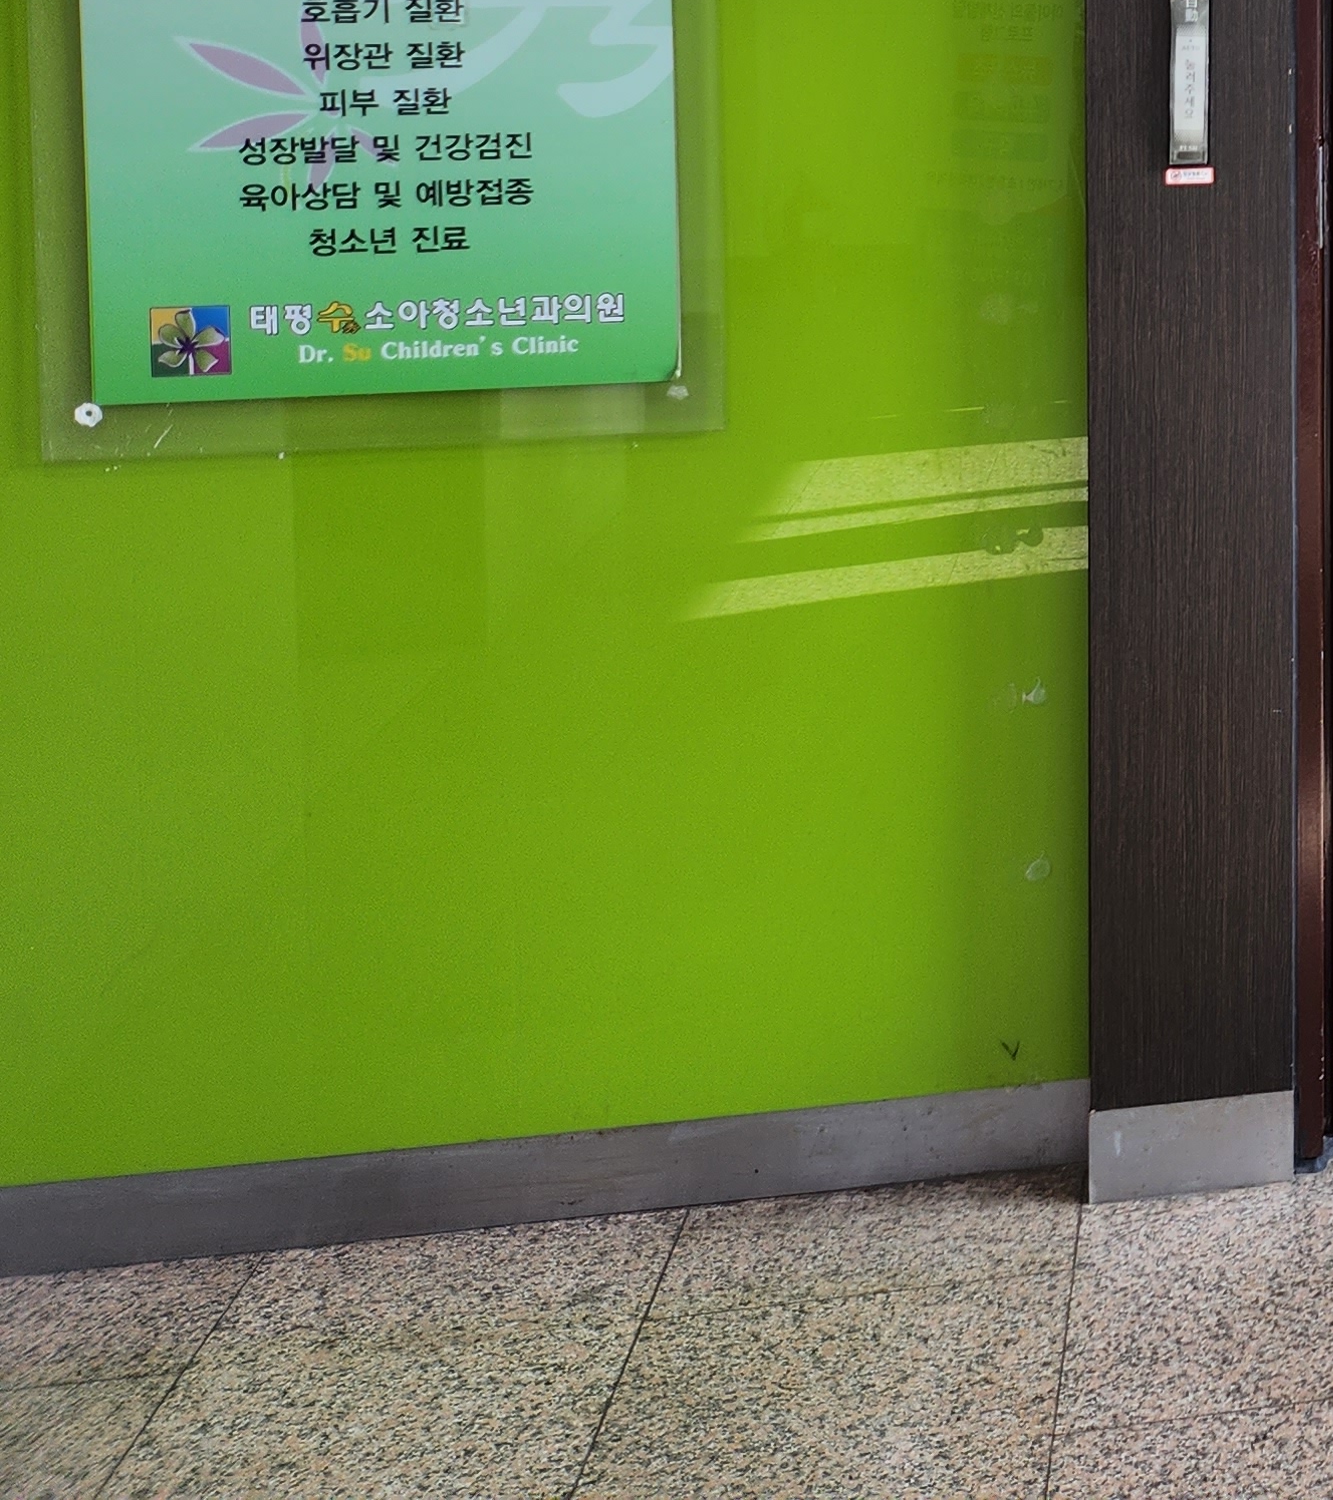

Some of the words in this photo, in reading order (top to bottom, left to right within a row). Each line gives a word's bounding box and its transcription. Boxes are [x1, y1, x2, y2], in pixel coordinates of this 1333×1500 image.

[303, 42, 392, 71] 위장관
[406, 41, 464, 70] 질환
[319, 89, 379, 117] 피부
[392, 87, 451, 116] 질환
[238, 135, 358, 166] 성장발달
[372, 134, 400, 162] 및
[415, 132, 533, 160] 건강검진
[239, 182, 358, 211] 육아상담
[374, 181, 401, 209] 및
[415, 178, 533, 207] 예방접종
[309, 226, 397, 257] 청소년
[412, 226, 470, 253] 진료
[299, 343, 334, 364] Dr.
[343, 342, 372, 362] Su
[512, 334, 579, 356] Clinic
